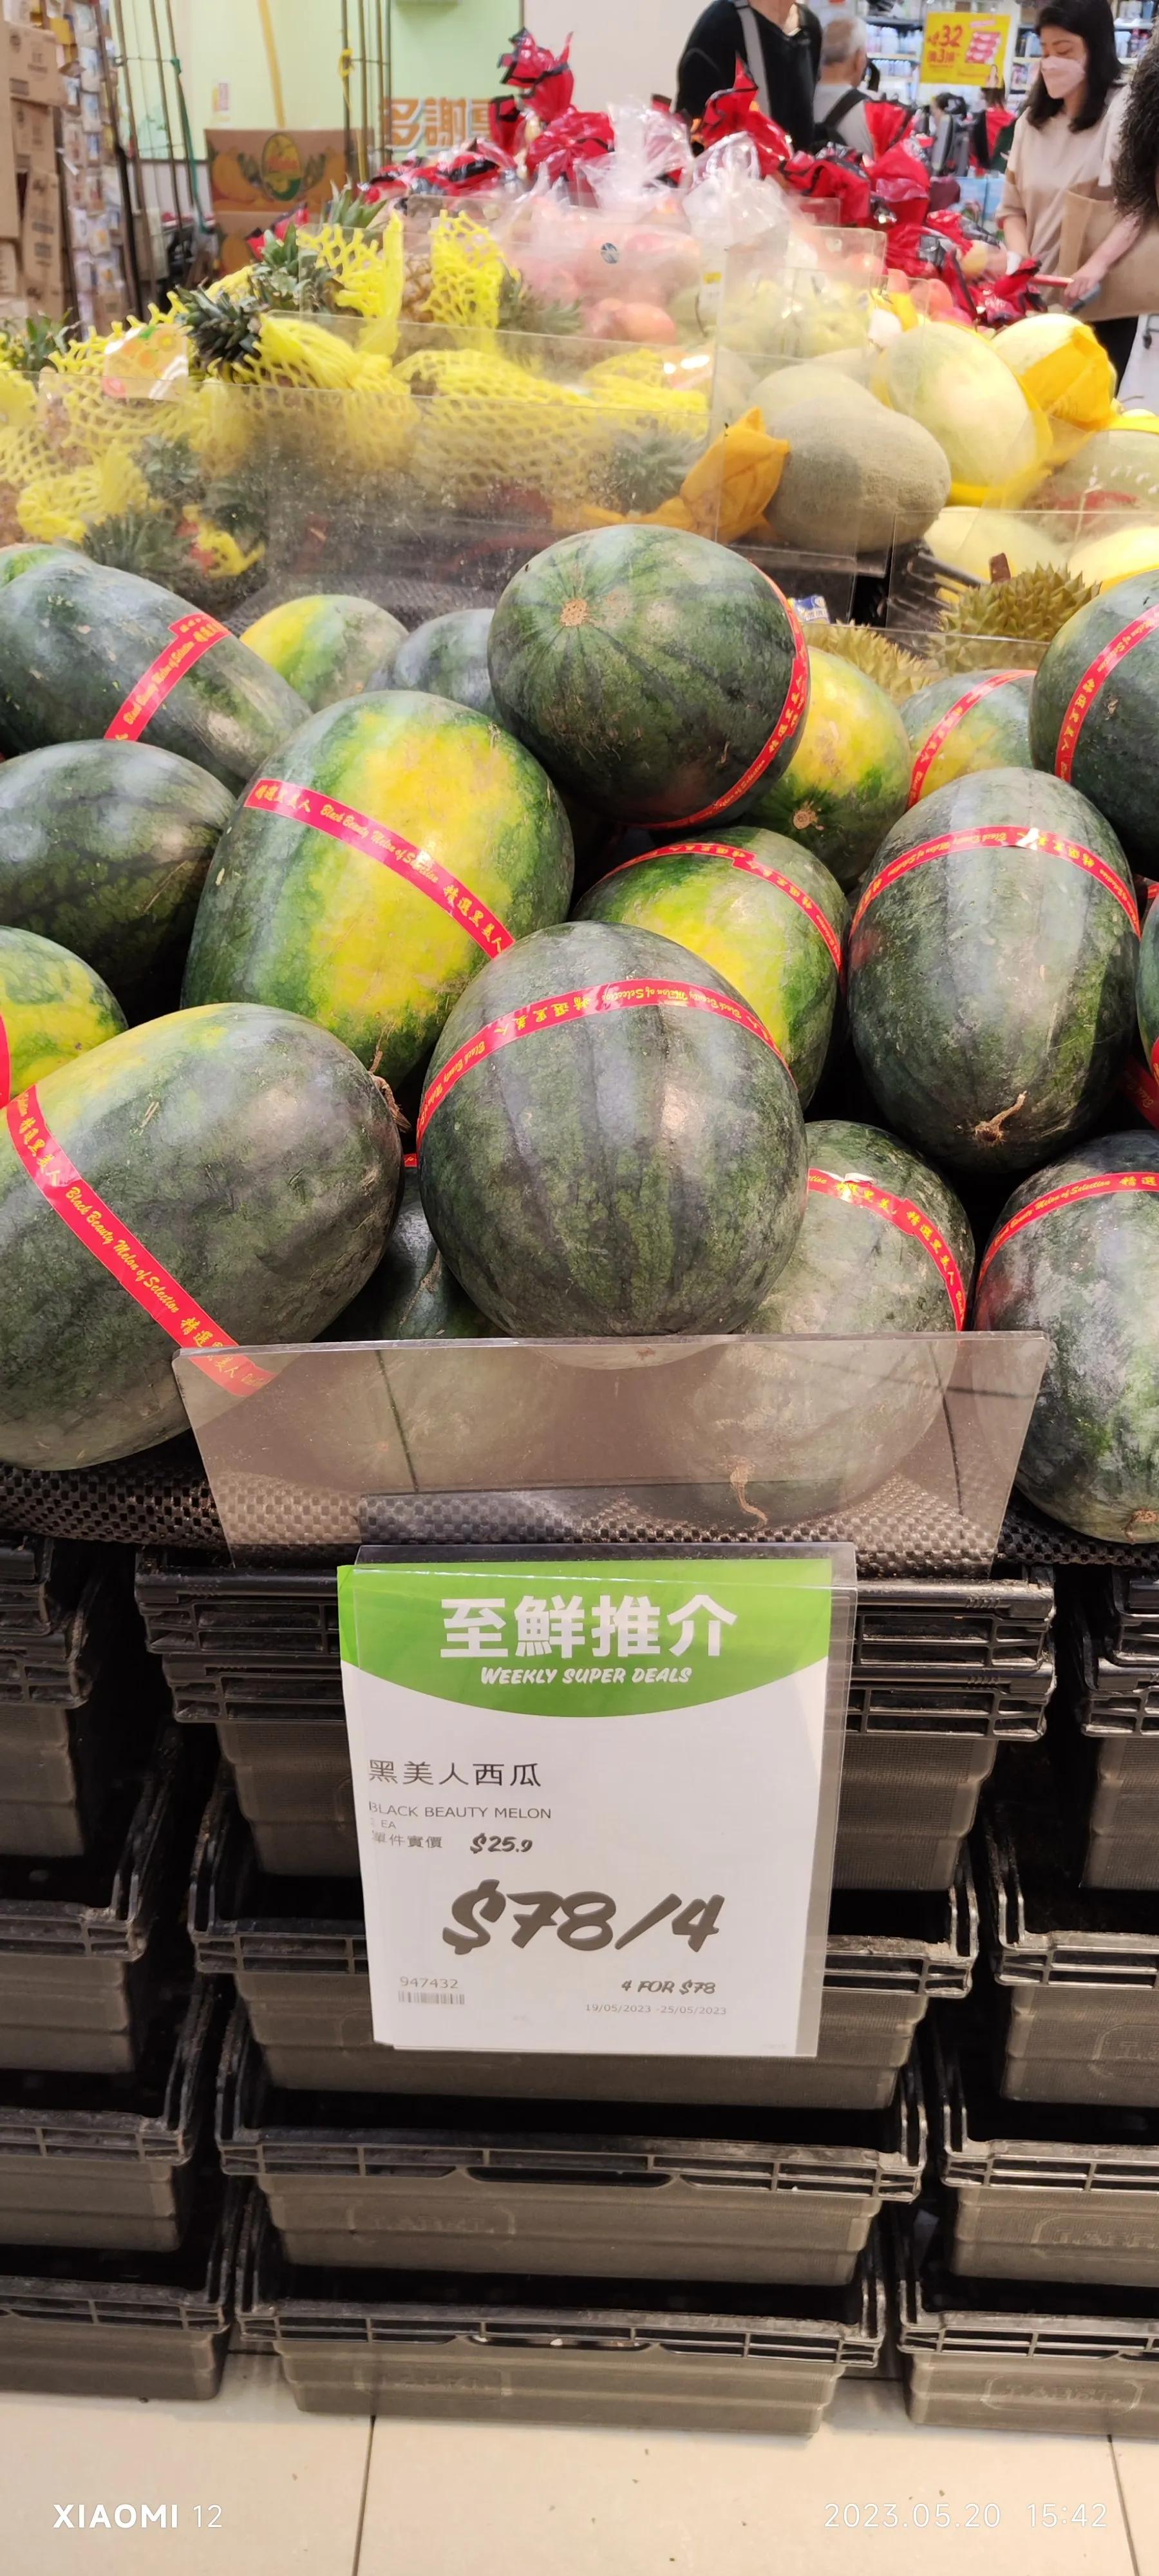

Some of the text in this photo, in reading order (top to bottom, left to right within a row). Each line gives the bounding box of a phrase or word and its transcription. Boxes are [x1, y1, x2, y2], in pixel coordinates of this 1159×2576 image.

[395, 849, 408, 861] of
[443, 884, 502, 954] 精選黑美人
[645, 986, 655, 998] of
[657, 989, 688, 1001] Melon
[19, 1117, 61, 1186] 精選黑美人
[1034, 1195, 1060, 1210] Melon
[1060, 1187, 1069, 1198] of
[1069, 1180, 1111, 1195] Selection
[66, 1186, 180, 1313] Black Beauty Melon of Selection
[907, 1211, 954, 1286] 精選黑美人
[440, 1595, 737, 1658] 至鮮推介
[562, 1668, 626, 1683] SUPER
[632, 1667, 692, 1683] DEALS
[369, 1759, 541, 1786] 黑美人西瓜
[369, 1801, 551, 1819] BLACK BEAUTY MELON
[470, 1833, 533, 1854] $25.9
[442, 1879, 725, 1955] $78/4
[400, 1976, 458, 1989] 947432
[621, 1979, 716, 1995] 4 FOR $78
[585, 2003, 652, 2013] 19/05/2023
